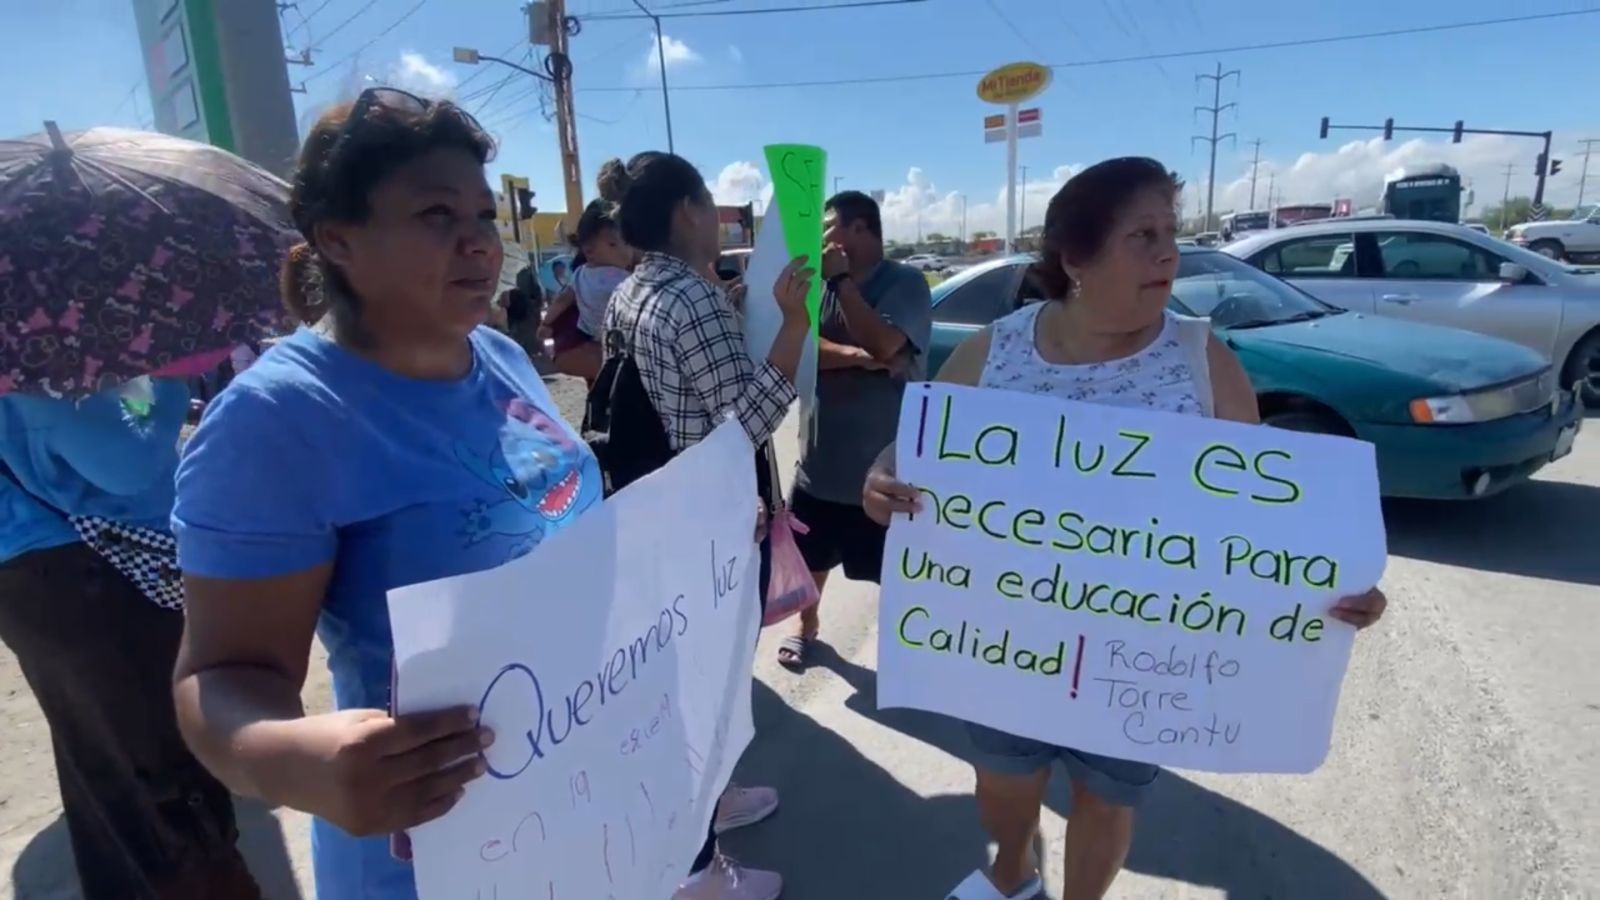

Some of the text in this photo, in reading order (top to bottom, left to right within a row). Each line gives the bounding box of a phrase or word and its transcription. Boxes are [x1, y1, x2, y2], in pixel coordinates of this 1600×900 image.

[1055, 414, 1157, 479] luz
[1193, 443, 1300, 504] es
[908, 482, 1338, 589] necesaria Para
[996, 563, 1247, 637] educación
[1269, 602, 1325, 643] de
[476, 538, 741, 780] Queremos luz
[1093, 677, 1192, 712] Torre
